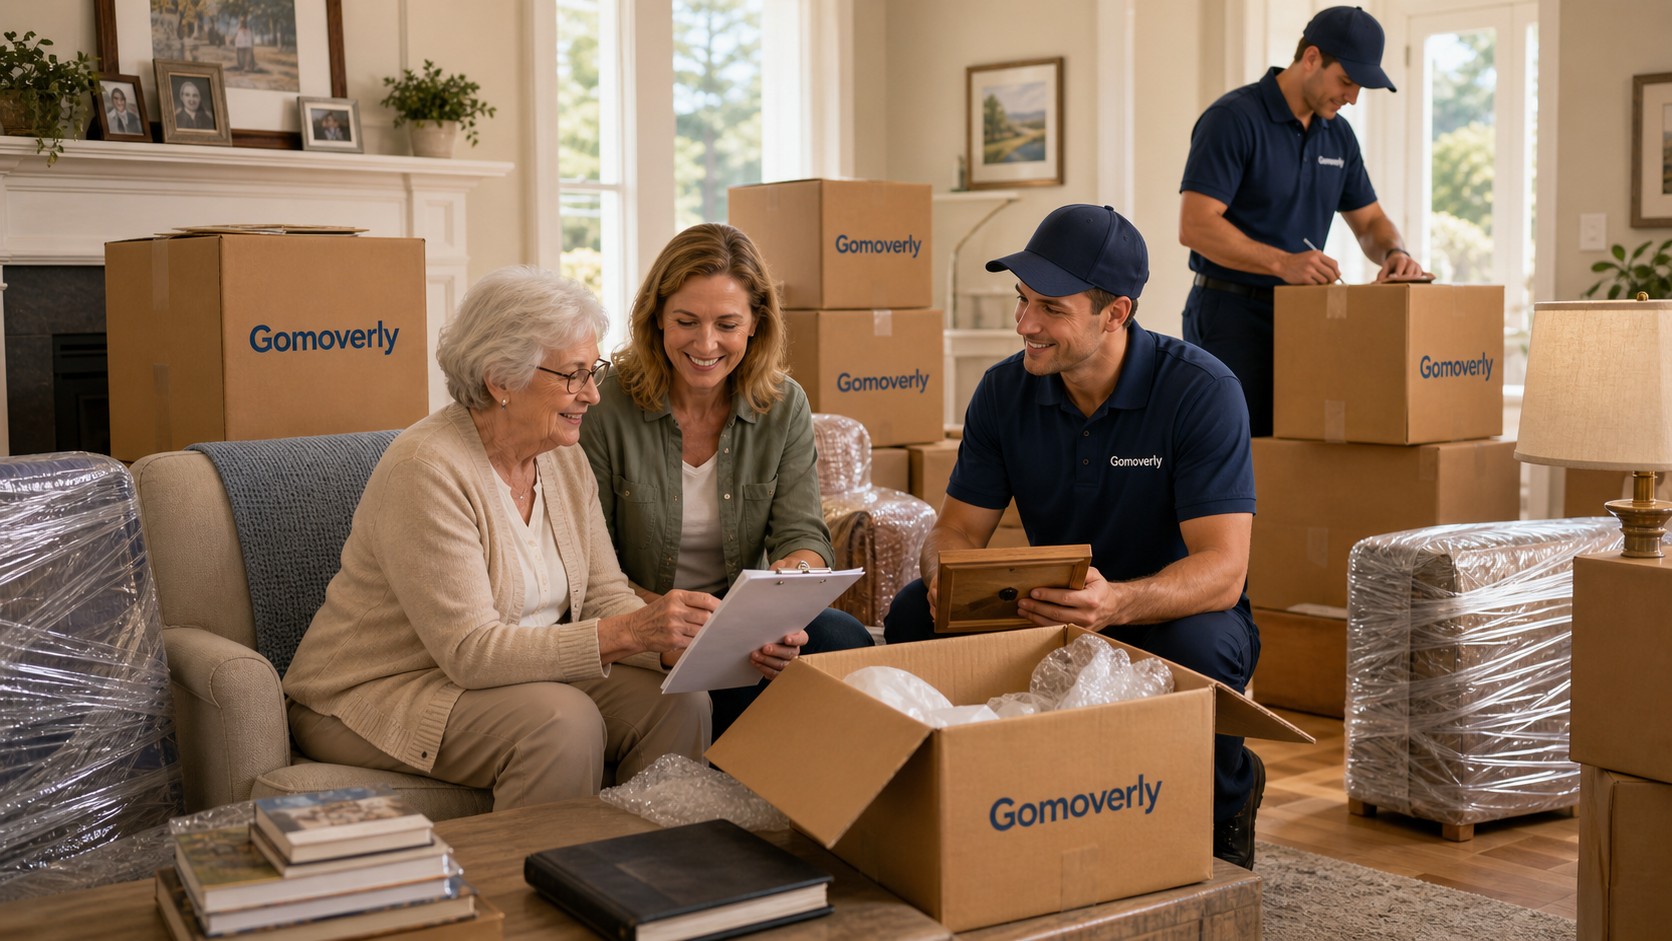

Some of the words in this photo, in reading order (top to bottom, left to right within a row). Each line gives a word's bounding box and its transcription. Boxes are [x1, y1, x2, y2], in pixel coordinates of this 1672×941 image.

[835, 233, 922, 259] Gomoverly
[249, 320, 400, 356] Gomoverly
[1420, 352, 1493, 381] Gomoverly
[836, 368, 930, 394] Gomoverly
[1110, 454, 1163, 470] Gomoverly
[989, 774, 1163, 832] Gomoverly
